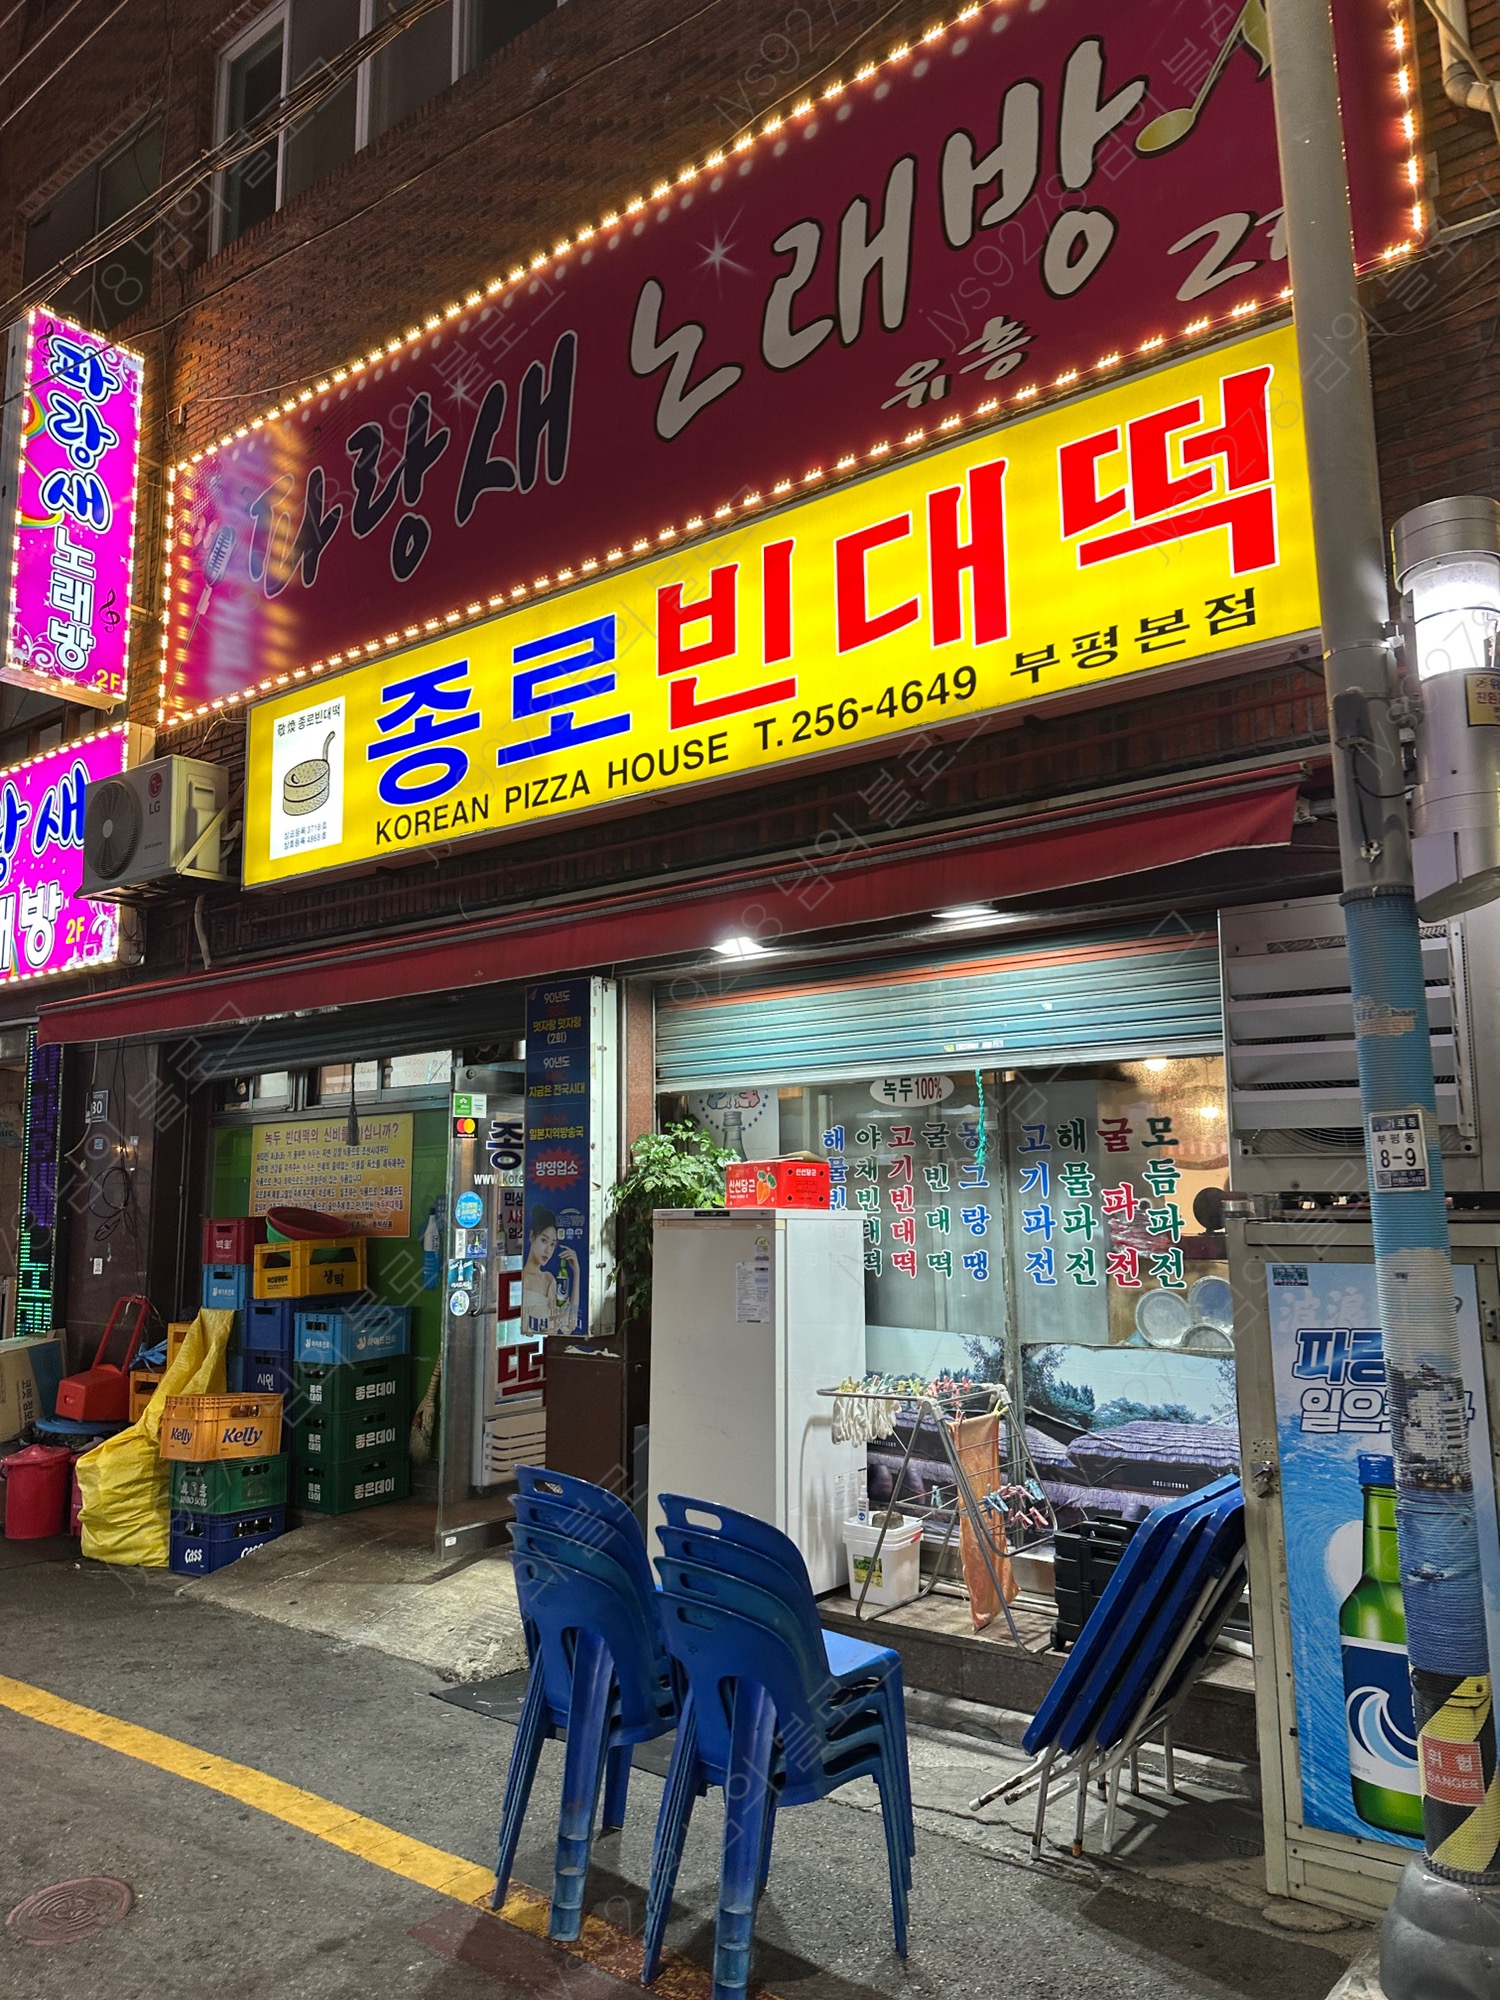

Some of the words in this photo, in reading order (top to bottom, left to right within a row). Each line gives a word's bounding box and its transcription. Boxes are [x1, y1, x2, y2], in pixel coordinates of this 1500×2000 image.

[630, 36, 1150, 442] 노래방
[40, 336, 120, 534] 파랑새
[49, 526, 98, 672] 노래방
[95, 668, 121, 690] 2F
[376, 794, 490, 845] KOREAN
[505, 769, 591, 815] PIZZA
[607, 731, 729, 790] HOUSE
[1010, 587, 1256, 685] 부평본점
[148, 800, 161, 815] LG
[66, 917, 85, 944] 2F
[543, 1056, 571, 1069] 90년도
[529, 1085, 552, 1098] 지금은
[553, 1081, 585, 1096] 전국시대
[265, 1131, 281, 1146] 녹두
[285, 1127, 319, 1145] 빈대떡의
[324, 1128, 348, 1143] 신비를
[529, 1126, 584, 1141] 일본지역방송국
[1377, 1132, 1416, 1145] 부평동
[535, 1160, 579, 1177] 방영업소
[823, 1125, 848, 1210] 해물빈
[1380, 1147, 1417, 1169] 8-9
[728, 1179, 756, 1194] 신선당근
[855, 1124, 883, 1278] 야채빈대떡
[887, 1125, 918, 1279] 고기빈대떡
[921, 1121, 953, 1280] 굴빈대떡
[957, 1122, 992, 1281] 동그랑땡
[1017, 1123, 1059, 1287] 고기파전
[1055, 1117, 1099, 1287] 해물파전
[1096, 1116, 1143, 1288] 굴파전
[1141, 1115, 1188, 1289] 모듬파전
[323, 1269, 345, 1286] 생탁
[257, 1373, 274, 1391] 시원
[355, 1381, 395, 1401] 좋은데이
[23, 1400, 34, 1424] 점보
[170, 1427, 193, 1446] Kelly
[222, 1426, 264, 1447] Kelly
[355, 1428, 395, 1449] 좋은데이
[354, 1477, 395, 1500] 좋은데이
[1426, 1771, 1479, 1790] DANGER
